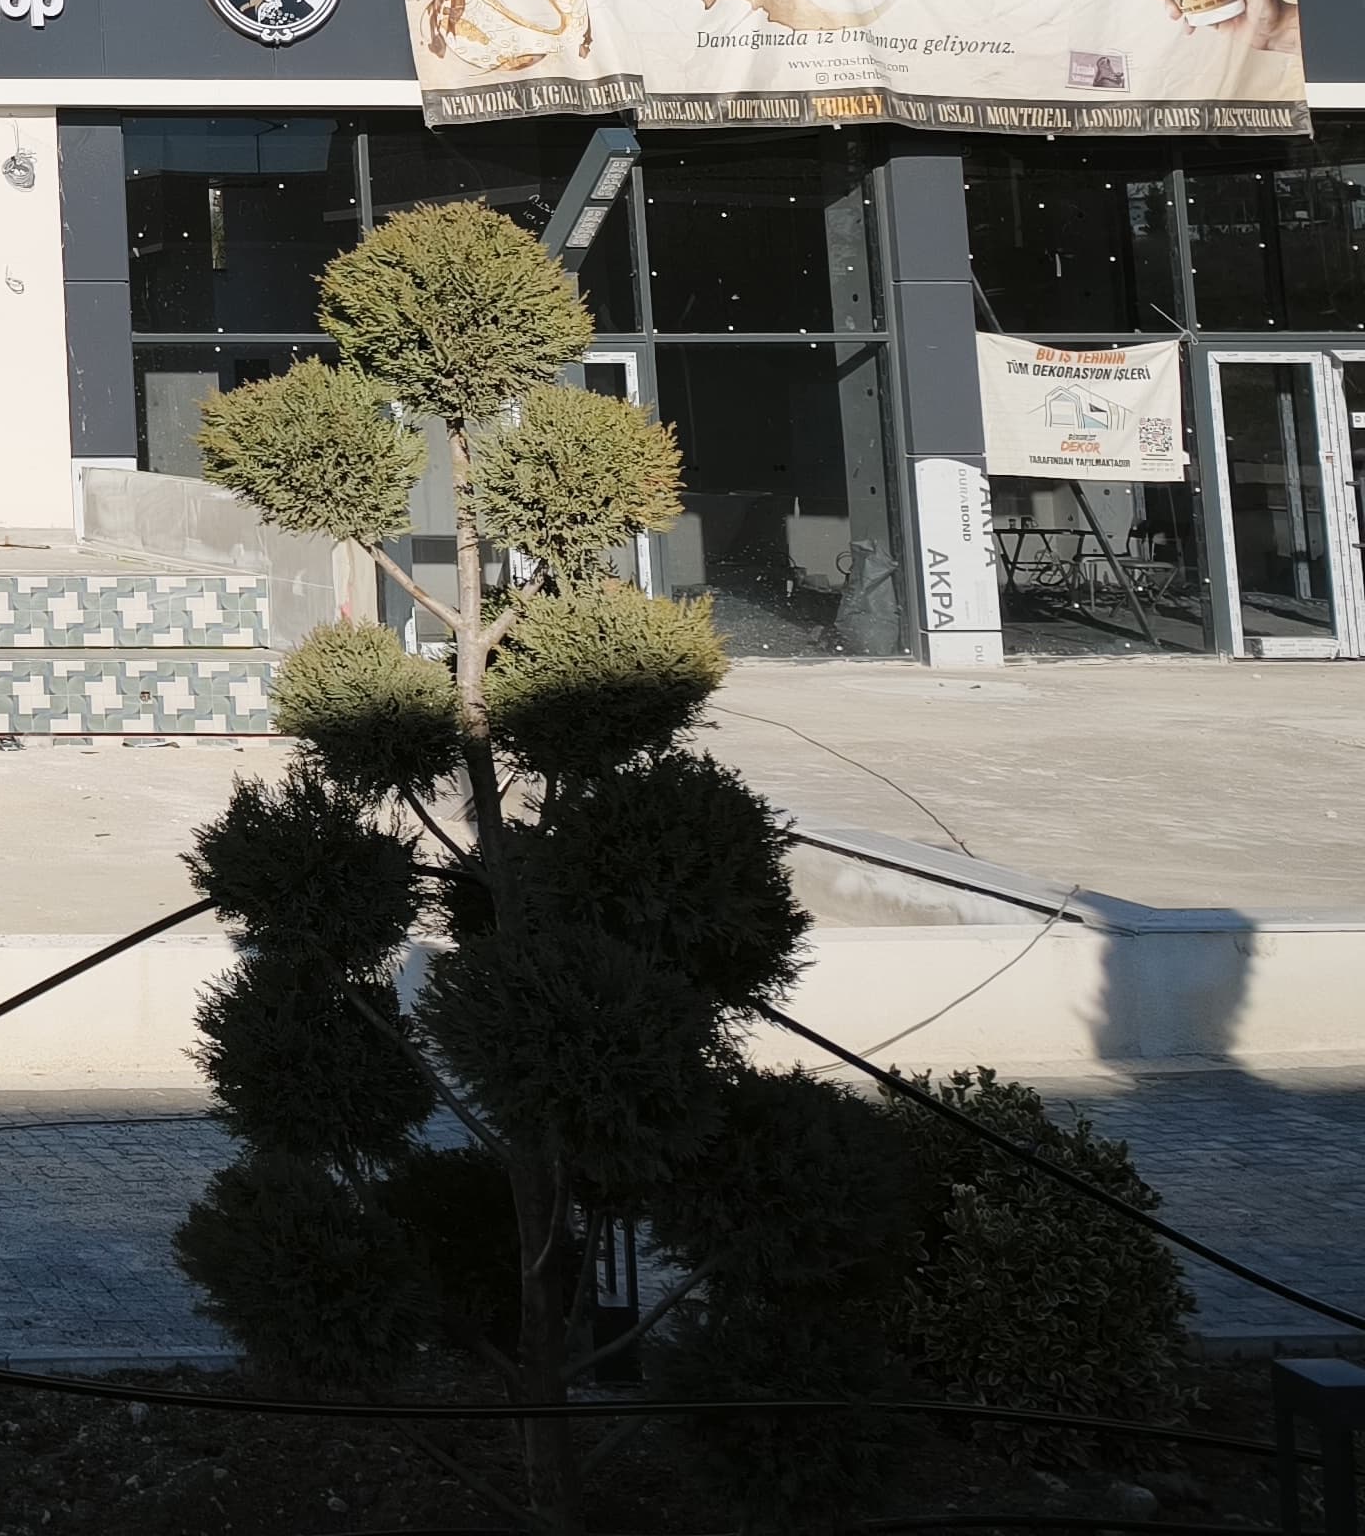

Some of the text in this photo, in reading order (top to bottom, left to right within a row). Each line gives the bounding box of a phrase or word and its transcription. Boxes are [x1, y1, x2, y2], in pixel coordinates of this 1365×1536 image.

[817, 27, 835, 45] iz
[923, 34, 1016, 56] geliyoruz.
[589, 81, 646, 106] BERLIN
[727, 98, 800, 120] DORTMUND
[938, 104, 975, 124] OSLO
[987, 105, 1072, 128] MONTREAL
[1082, 107, 1142, 128] LONDON
[1154, 107, 1200, 128] PARIS
[1213, 107, 1293, 128] AMSTERDAM
[1036, 347, 1055, 361] BU
[1006, 359, 1152, 382] TÜM DEKORASYON İŞLERİ
[1060, 440, 1102, 455] DEKOR
[957, 468, 972, 543] DURABOND
[927, 548, 955, 629] AKPA
